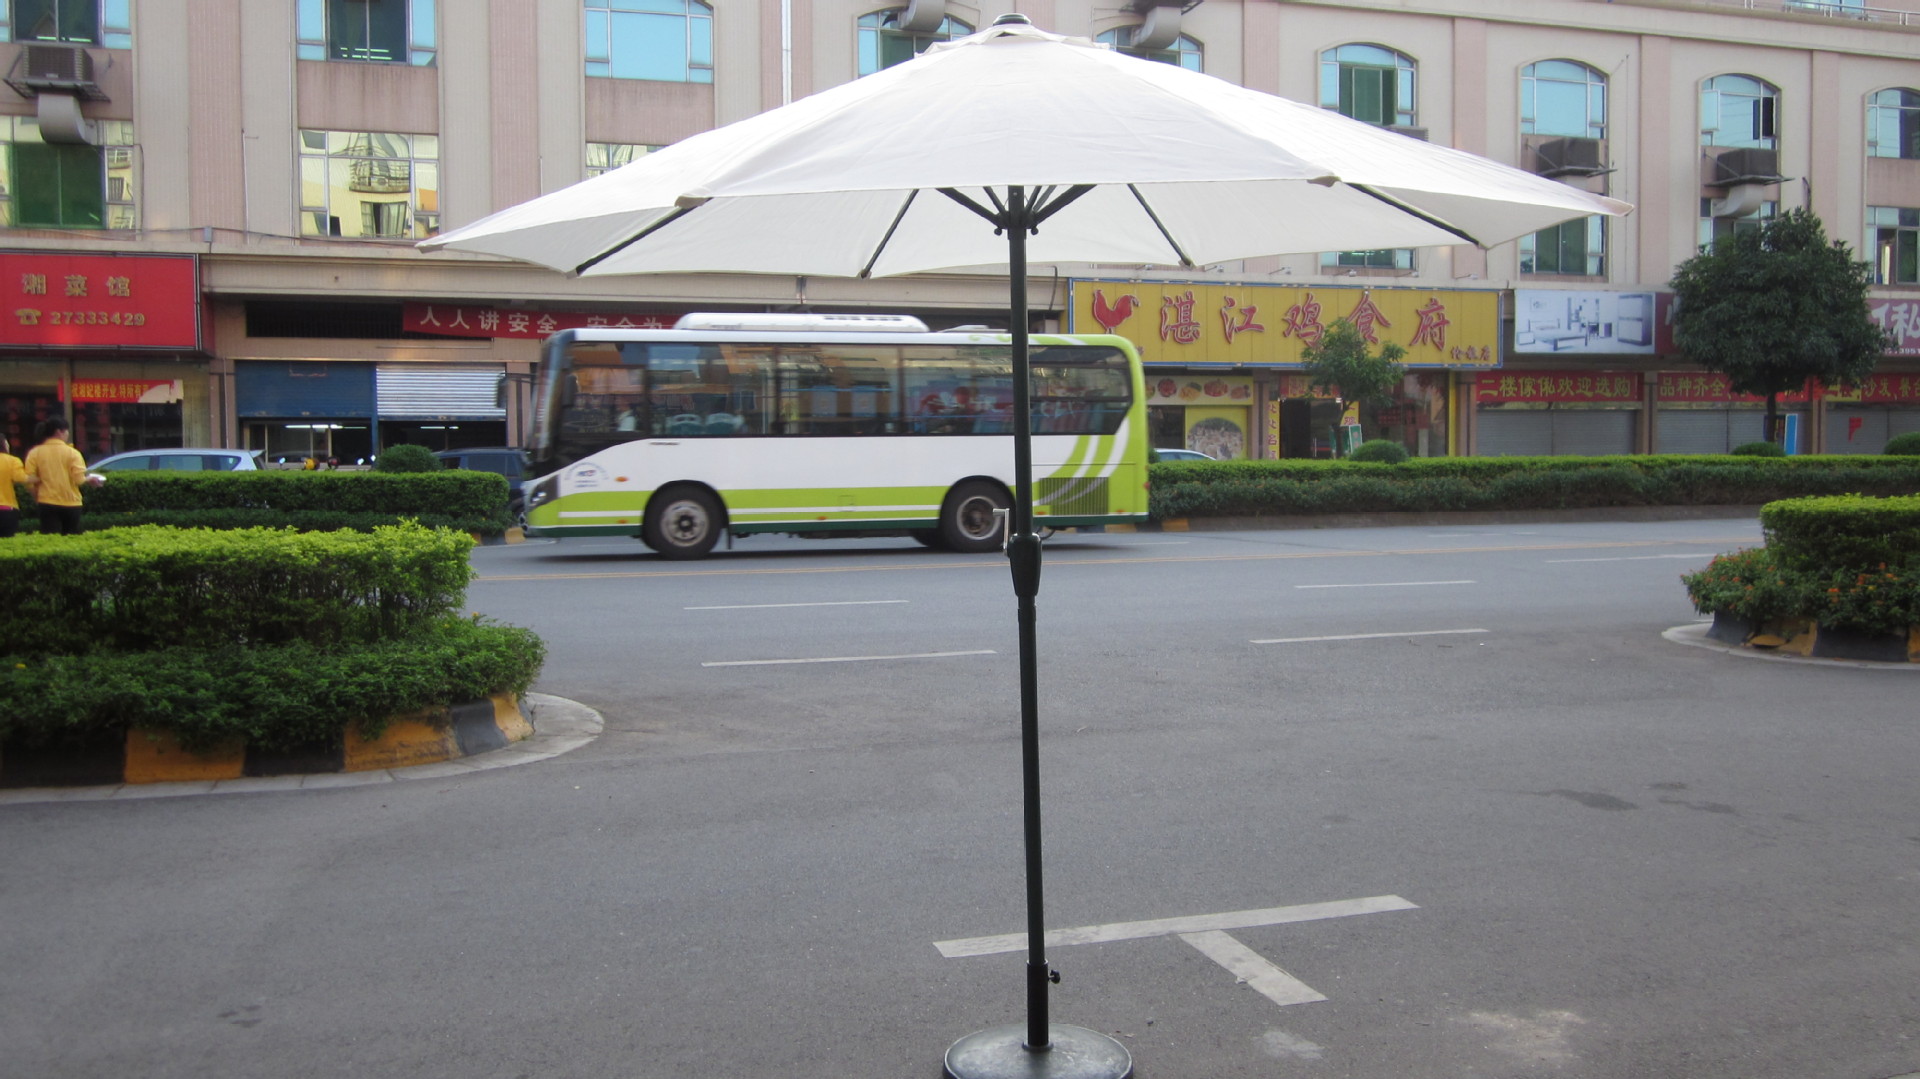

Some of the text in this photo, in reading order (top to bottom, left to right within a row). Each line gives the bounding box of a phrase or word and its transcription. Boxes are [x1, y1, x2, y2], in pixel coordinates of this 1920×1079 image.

[22, 273, 131, 297] 湘菜馆
[50, 311, 145, 326] 27333429
[420, 306, 558, 334] 人人讲安全
[1160, 291, 1450, 351] 湛江鸡食府
